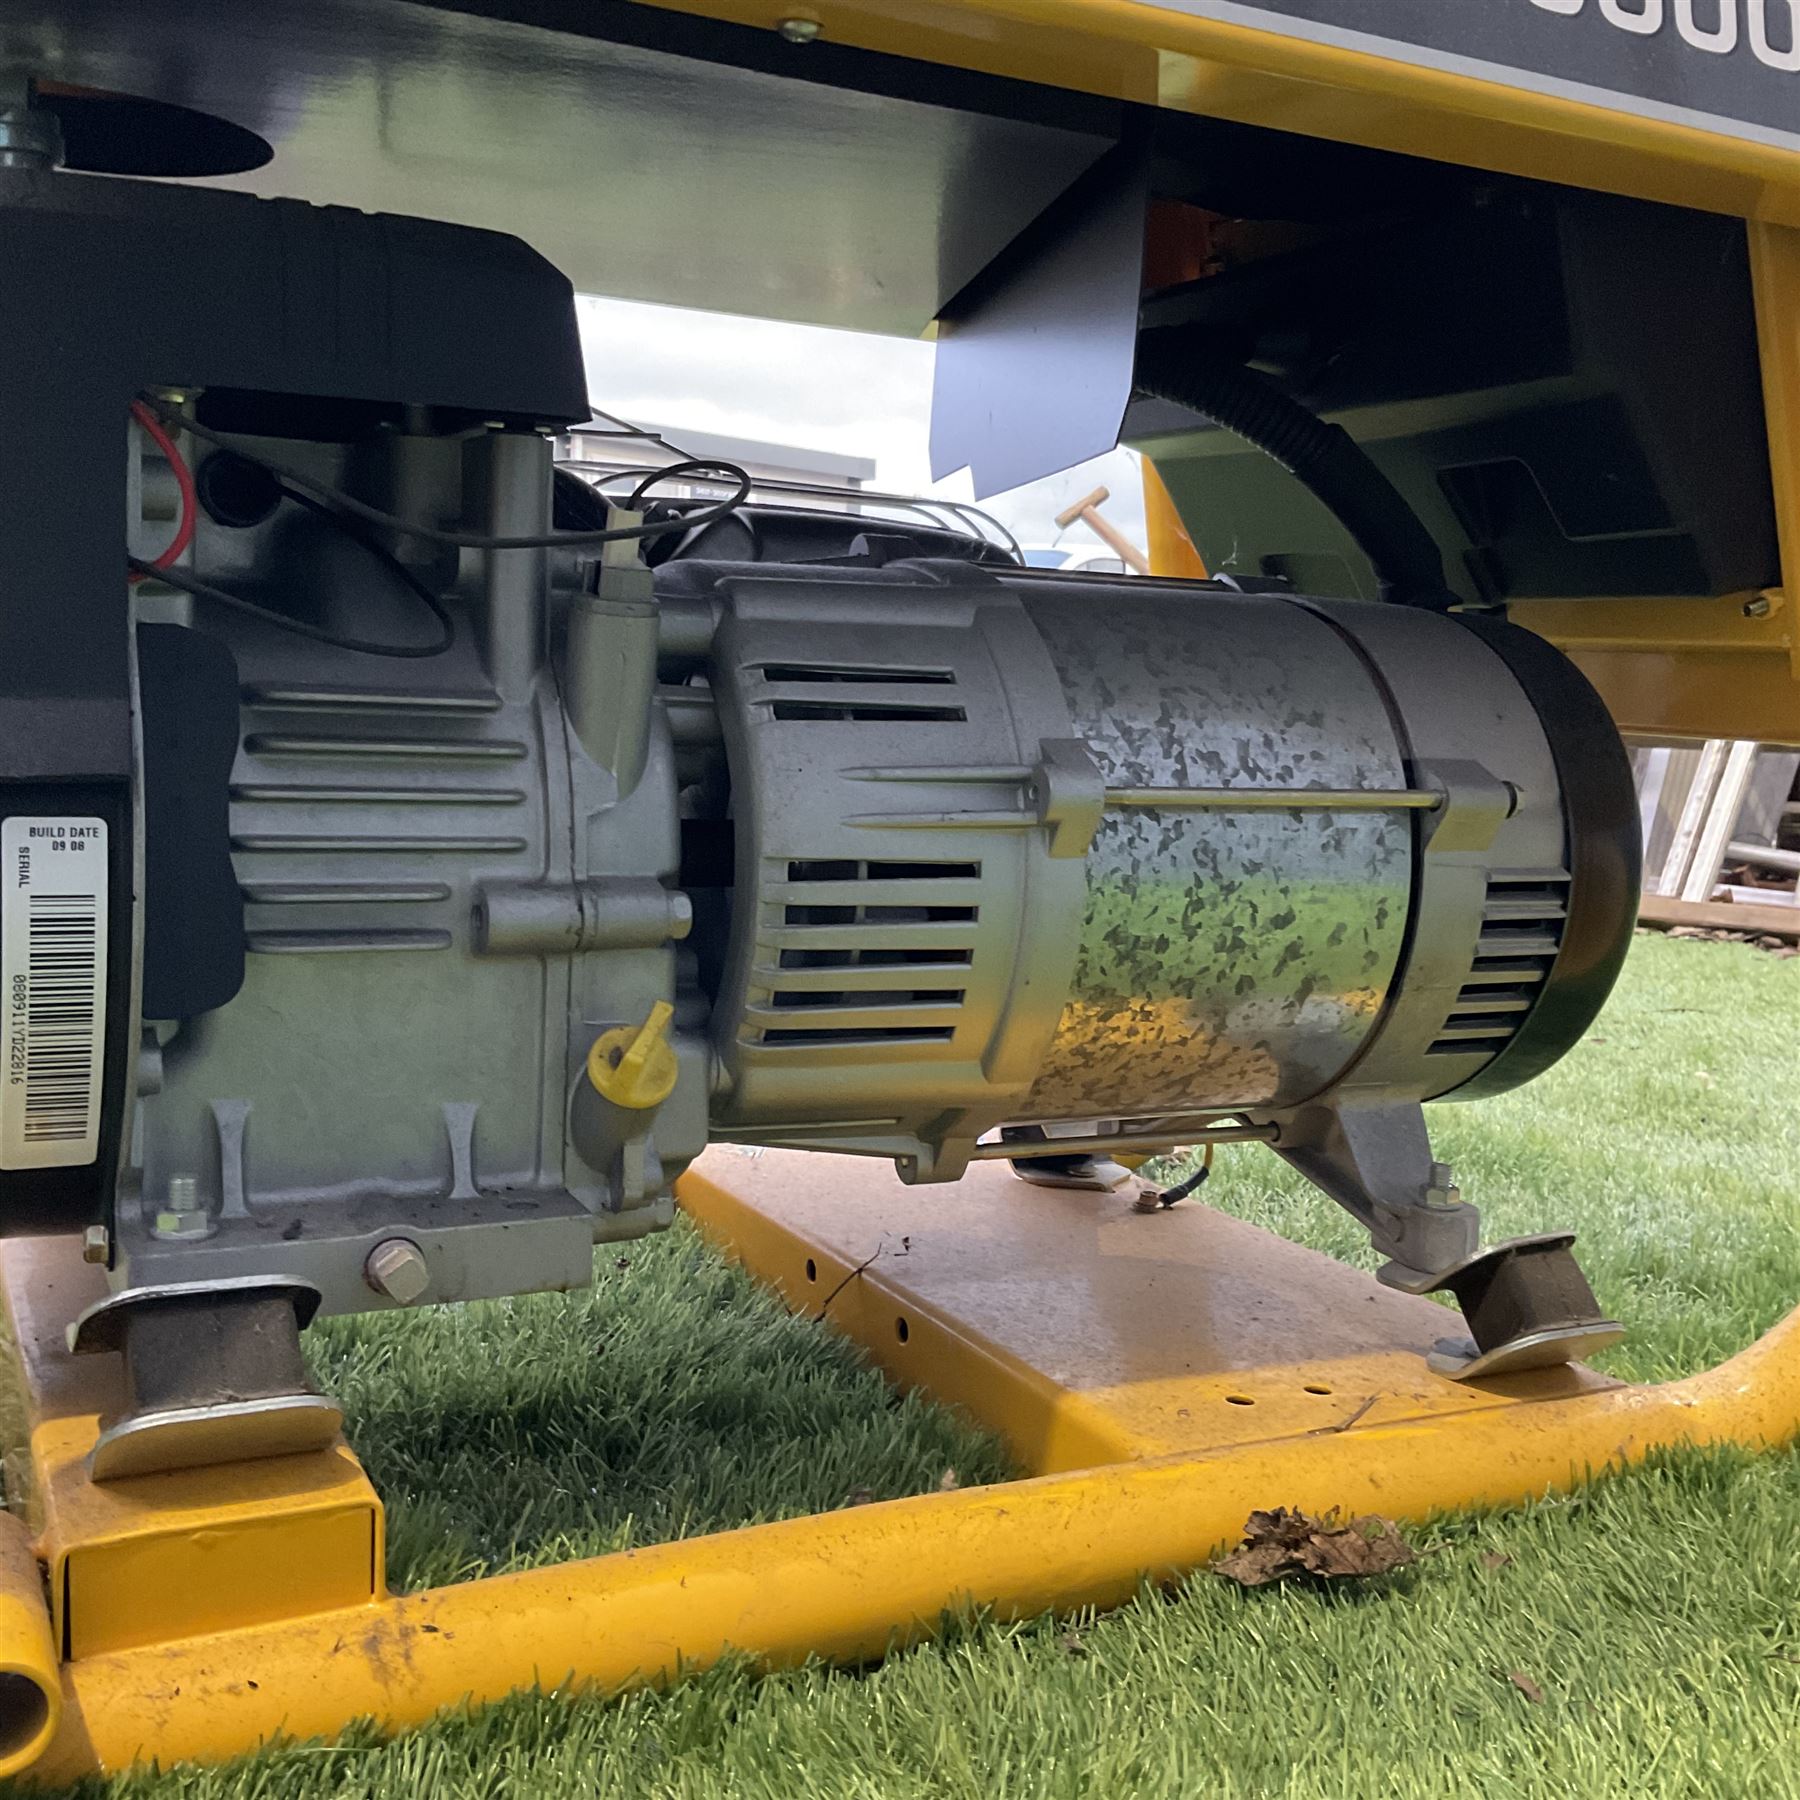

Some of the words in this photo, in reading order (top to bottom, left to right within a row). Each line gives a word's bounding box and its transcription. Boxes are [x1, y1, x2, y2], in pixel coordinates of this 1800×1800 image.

[29, 827, 66, 838] BUILD
[69, 827, 100, 838] DATE
[52, 840, 66, 852] 09
[18, 846, 31, 889] SERIAL
[10, 974, 27, 1086] 080911YD22816
